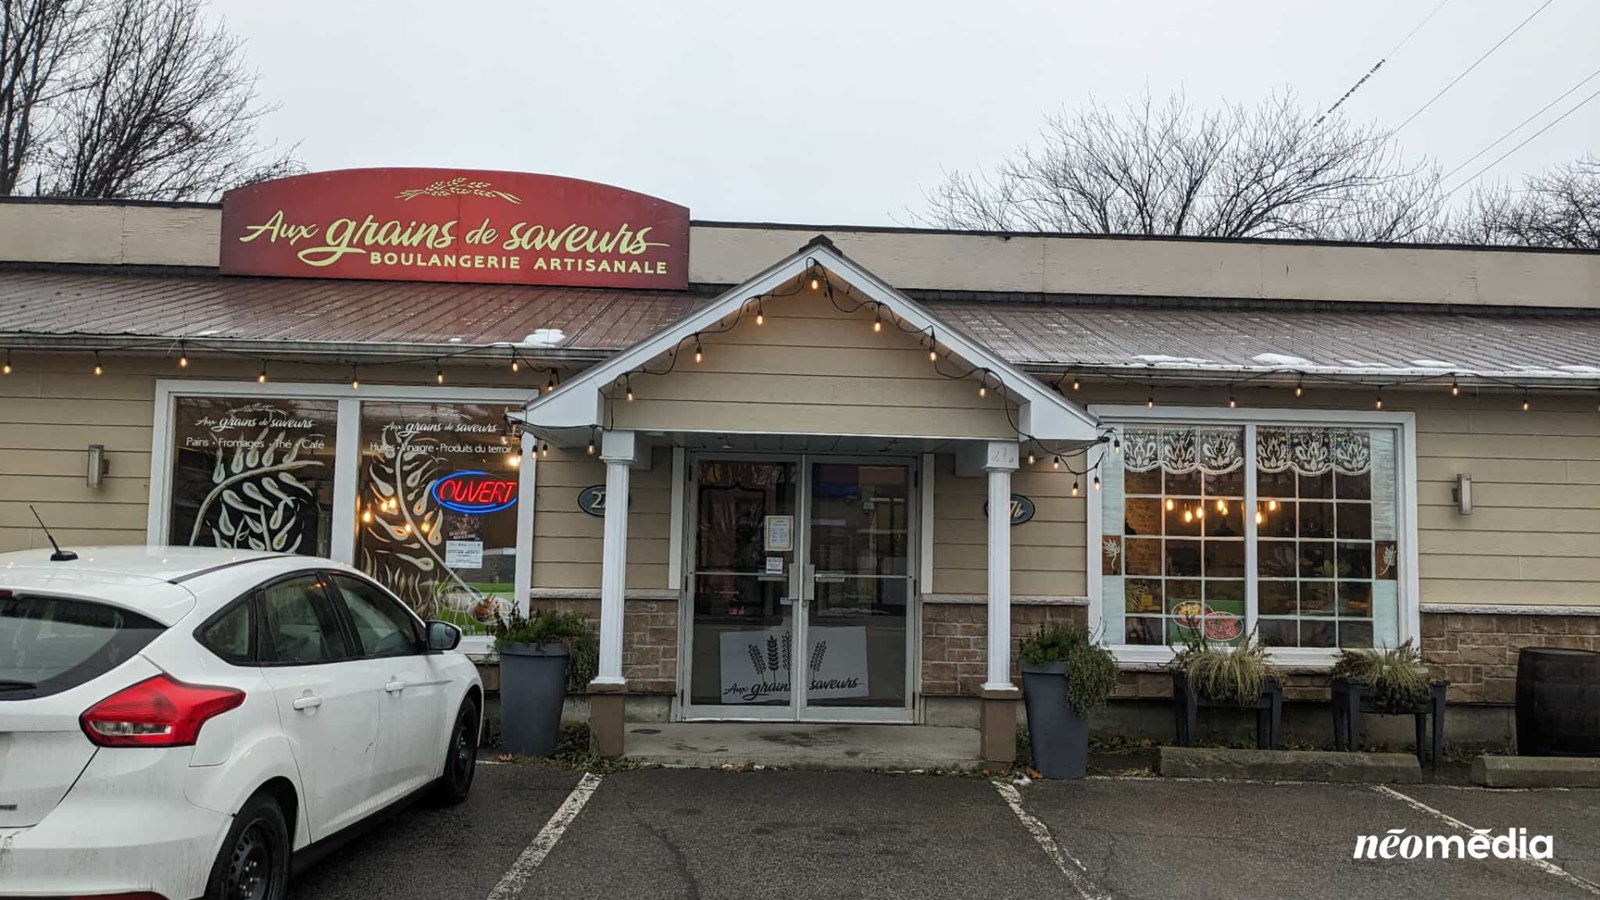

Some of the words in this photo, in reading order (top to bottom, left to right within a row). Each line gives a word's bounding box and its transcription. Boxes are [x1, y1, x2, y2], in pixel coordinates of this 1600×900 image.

[239, 210, 319, 246] Aux
[297, 213, 459, 267] grains
[465, 218, 499, 244] de
[502, 222, 671, 255] saveurs
[370, 252, 521, 270] BOULANGERIE
[533, 257, 668, 275] ARTISANALE
[211, 417, 257, 432] grains
[270, 418, 318, 428] saveurs
[397, 422, 442, 437] grains
[455, 424, 502, 433] saveurs
[186, 437, 209, 447] Pains
[218, 438, 265, 450] Fromages
[301, 439, 326, 450] Café
[440, 443, 473, 453] Produits
[475, 444, 486, 453] du
[440, 479, 517, 503] OUVERT
[723, 682, 749, 695] Aux
[808, 677, 866, 691] saveurs
